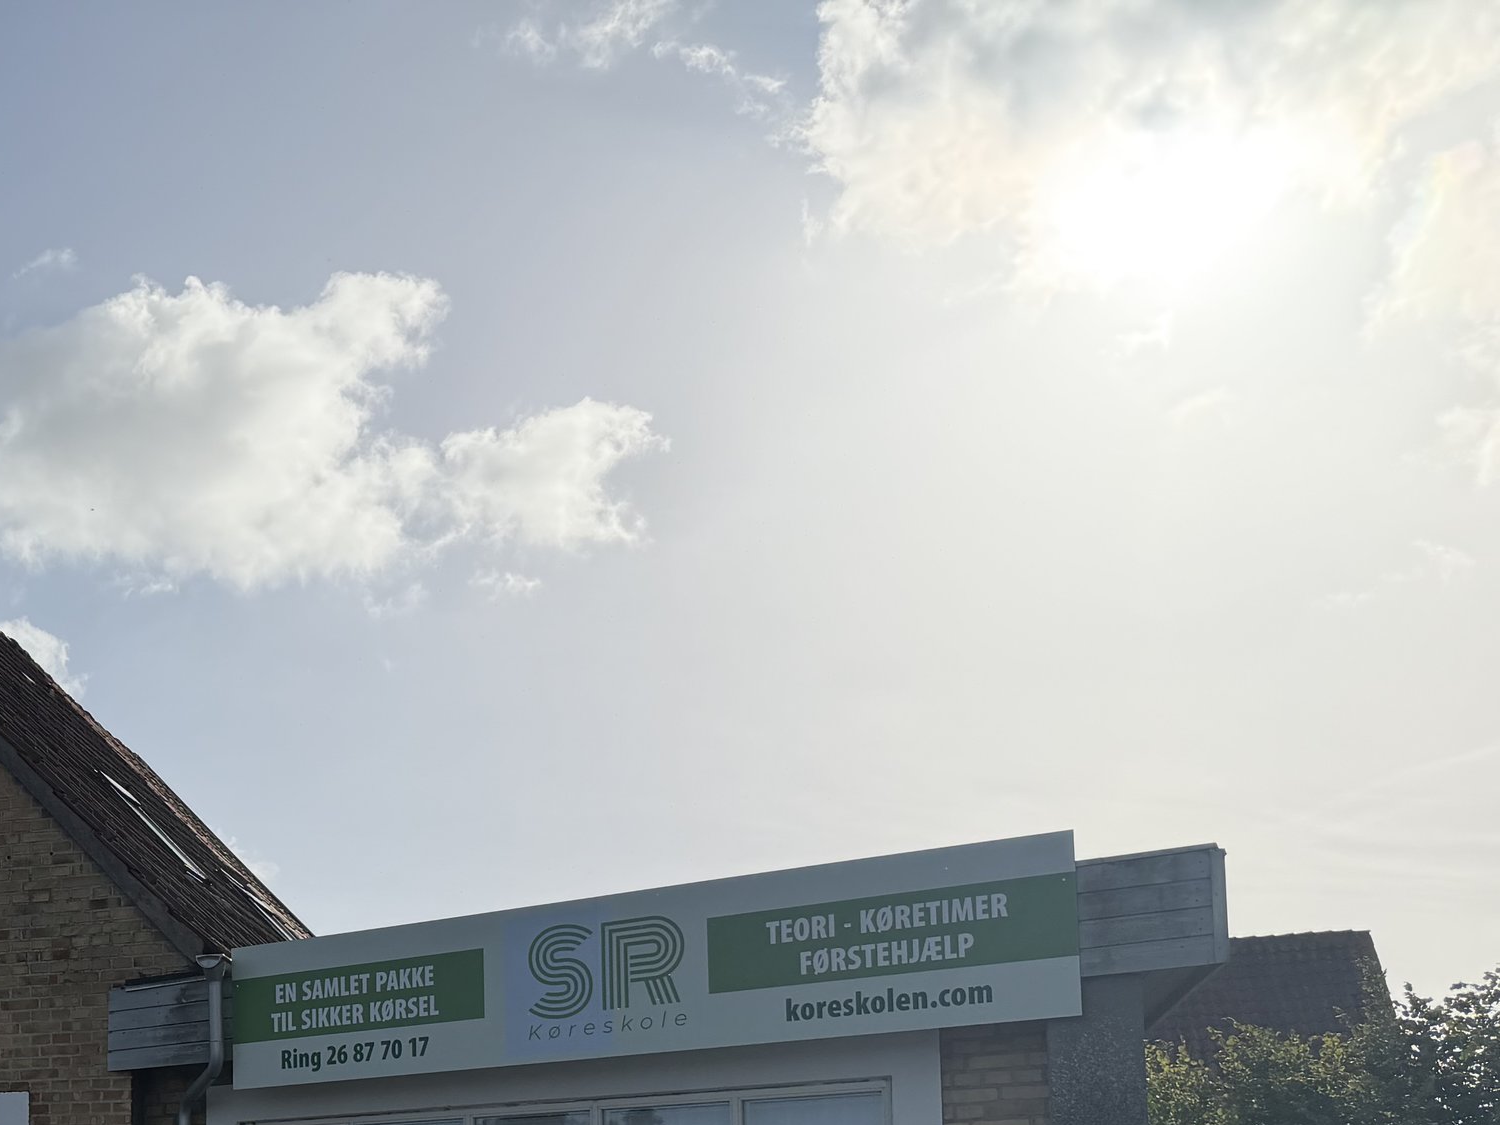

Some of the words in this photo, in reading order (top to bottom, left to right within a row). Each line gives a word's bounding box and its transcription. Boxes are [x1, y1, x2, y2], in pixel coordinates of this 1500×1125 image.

[766, 914, 835, 944] TEORI
[860, 893, 1009, 934] KØRETIMER
[529, 915, 684, 1019] SR
[800, 933, 975, 976] FØRSTEHJÆLP
[275, 983, 296, 1004] EN
[302, 974, 370, 1001] SAMLET
[375, 966, 434, 992] PAKKE
[785, 983, 993, 1022] koreskolen.com
[271, 1011, 296, 1032] TIL
[301, 1003, 364, 1029] SIKKER
[369, 995, 439, 1023] KØRSEL
[529, 1011, 687, 1040] Køreskole
[281, 1048, 321, 1072] Ring
[326, 1044, 347, 1064] 26
[353, 1042, 374, 1062] 87
[382, 1039, 402, 1059] 70
[408, 1037, 429, 1057] 17
